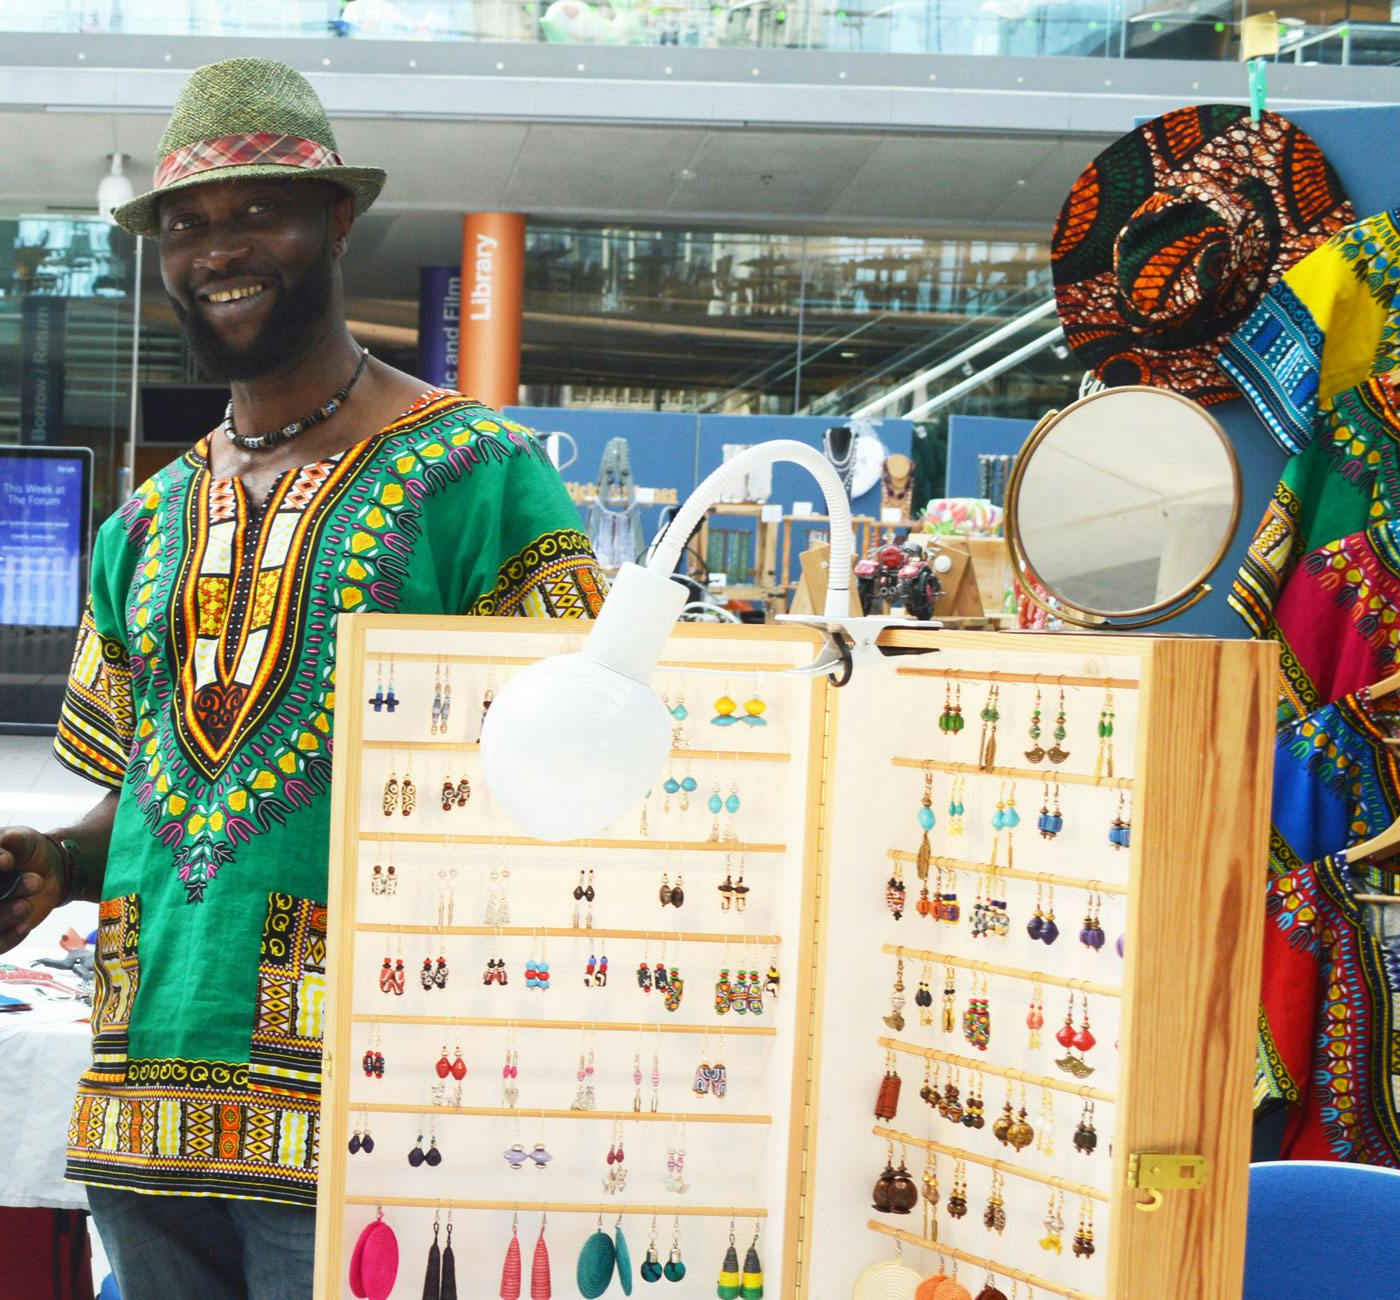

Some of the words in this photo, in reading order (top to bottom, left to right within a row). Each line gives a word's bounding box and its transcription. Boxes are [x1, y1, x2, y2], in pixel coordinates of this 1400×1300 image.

[443, 276, 460, 321] Film
[471, 234, 498, 320] Library
[32, 306, 50, 363] Return
[443, 328, 459, 365] and
[31, 378, 47, 441] Borrow
[3, 482, 23, 493] This
[25, 483, 53, 494] Week
[55, 485, 66, 495] at
[8, 494, 26, 504] The
[28, 494, 61, 505] Forum
